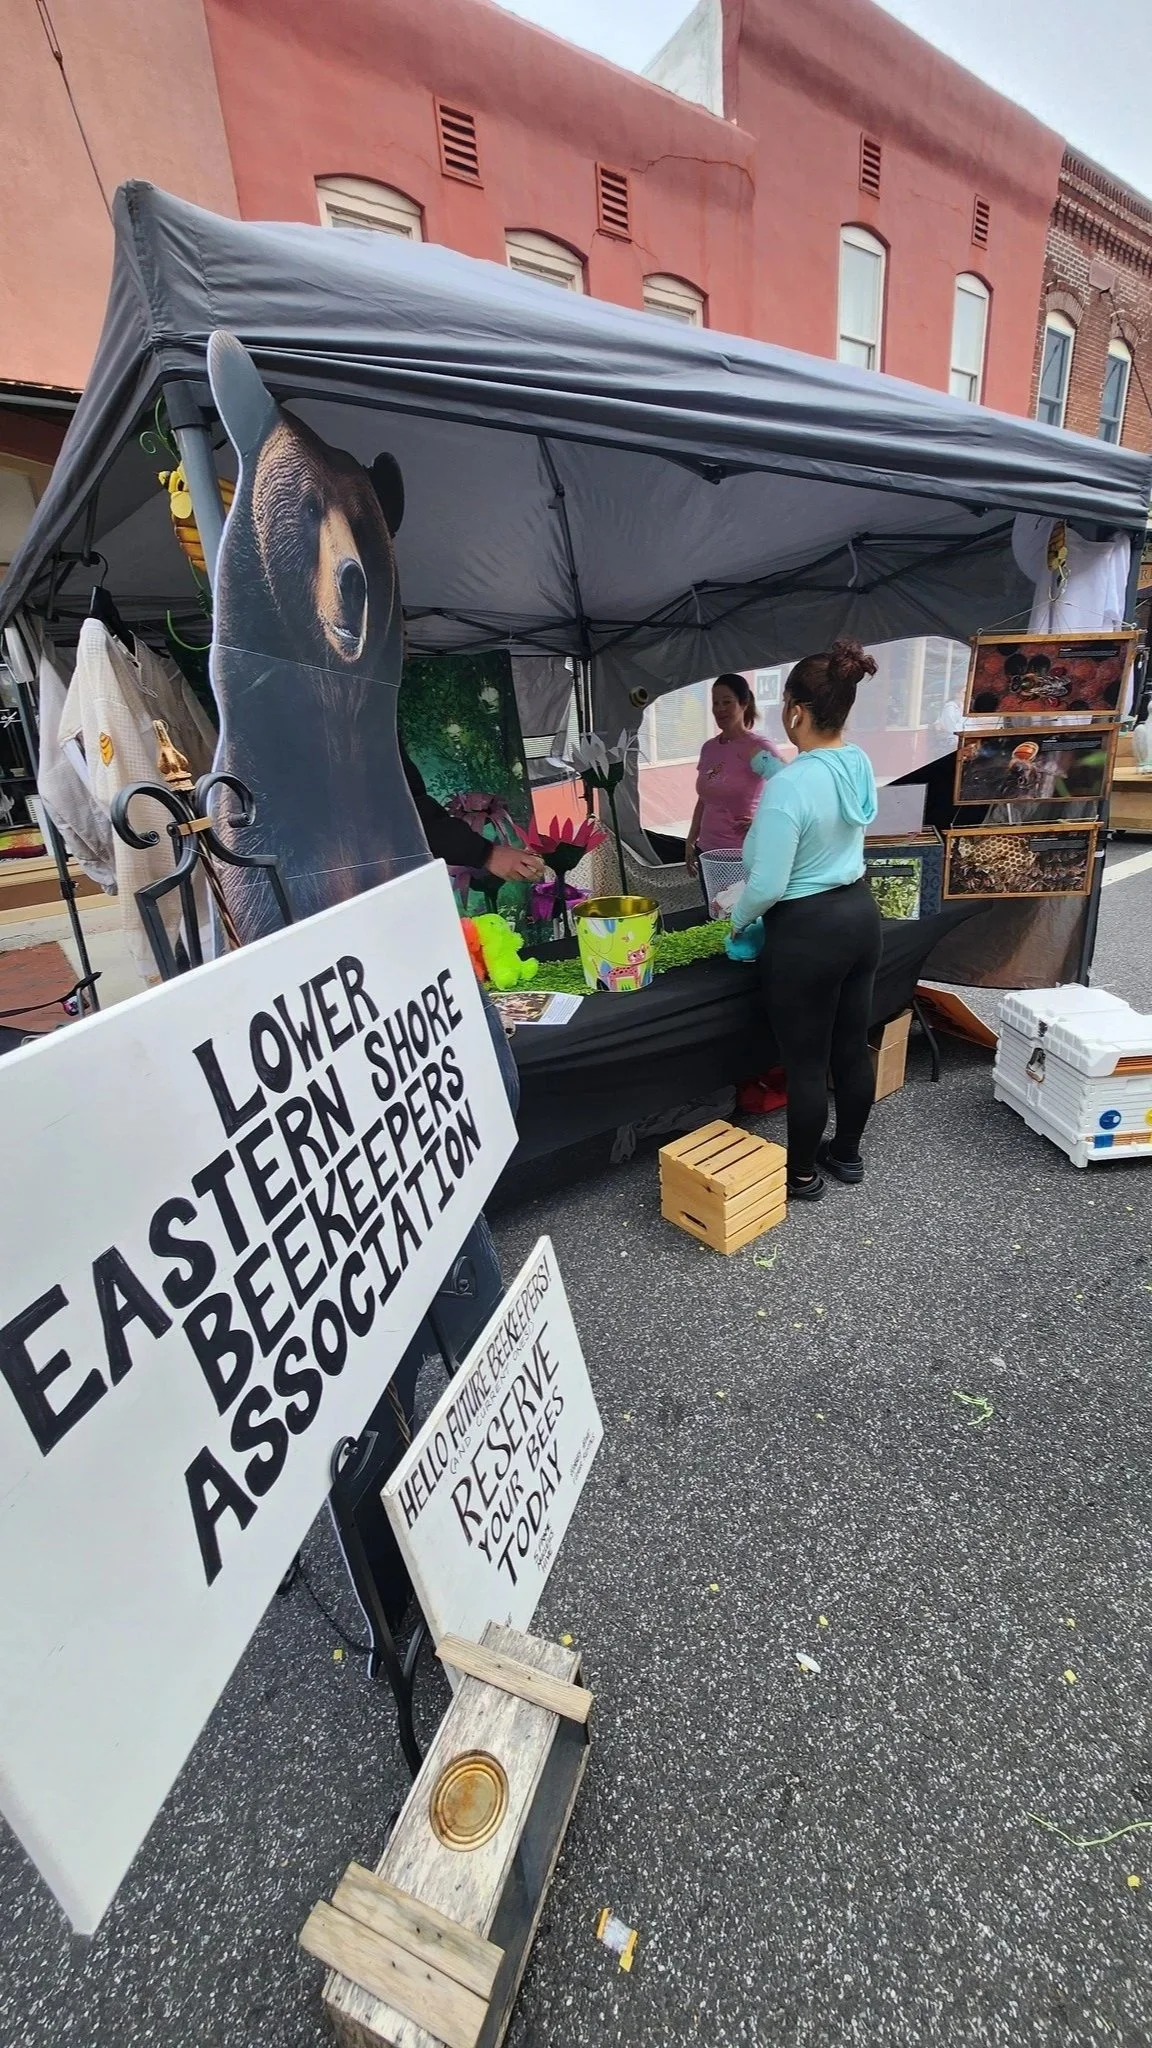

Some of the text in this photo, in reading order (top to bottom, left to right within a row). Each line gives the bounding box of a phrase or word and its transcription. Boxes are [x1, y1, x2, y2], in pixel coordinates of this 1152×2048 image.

[193, 956, 379, 1139] LOWER
[0, 969, 462, 1457] EASTERN SHORE
[182, 1046, 463, 1416] BEEKEEPERS
[184, 1099, 481, 1586] ASSOCIATION
[398, 1254, 551, 1529] HELLO FUTURE BEEKEEPERS!
[450, 1437, 471, 1474] (AND
[476, 1362, 509, 1427] CURRENT
[450, 1320, 560, 1546] RESERVE
[478, 1469, 524, 1563] YOUR
[526, 1385, 564, 1472] BEES
[497, 1439, 562, 1586] TODAY
